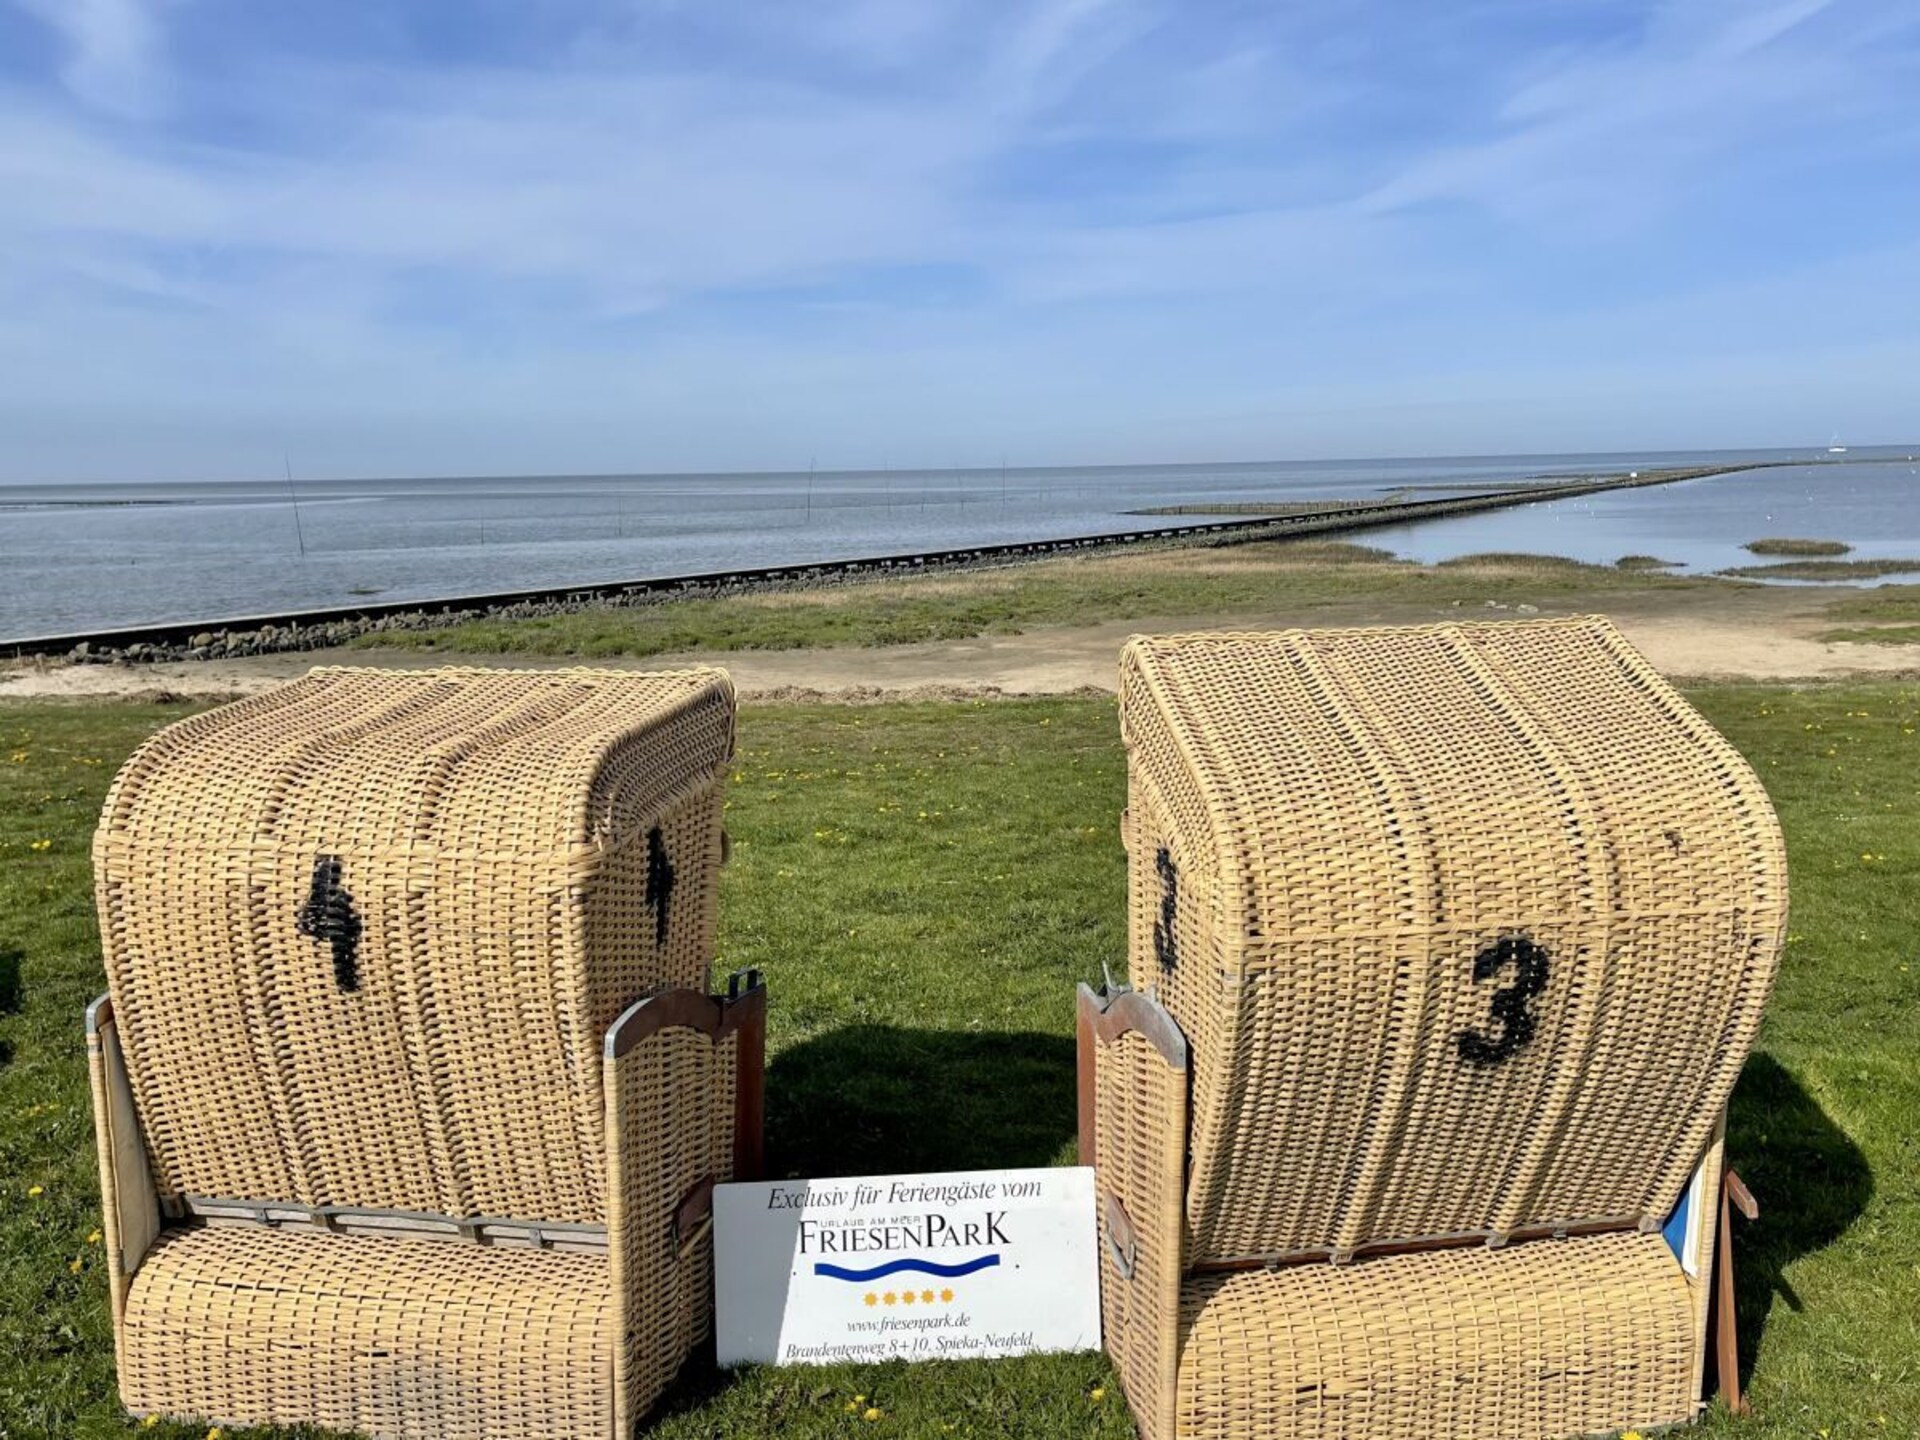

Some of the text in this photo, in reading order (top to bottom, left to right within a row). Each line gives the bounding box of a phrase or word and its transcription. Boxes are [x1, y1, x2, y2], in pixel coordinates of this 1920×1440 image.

[1458, 935, 1550, 1067] 3
[767, 1180, 1042, 1211] Exclusiv für Feriengäste vom
[820, 1215, 921, 1228] URLAUB AM MEER
[847, 1312, 971, 1335] www.friesenpark.de
